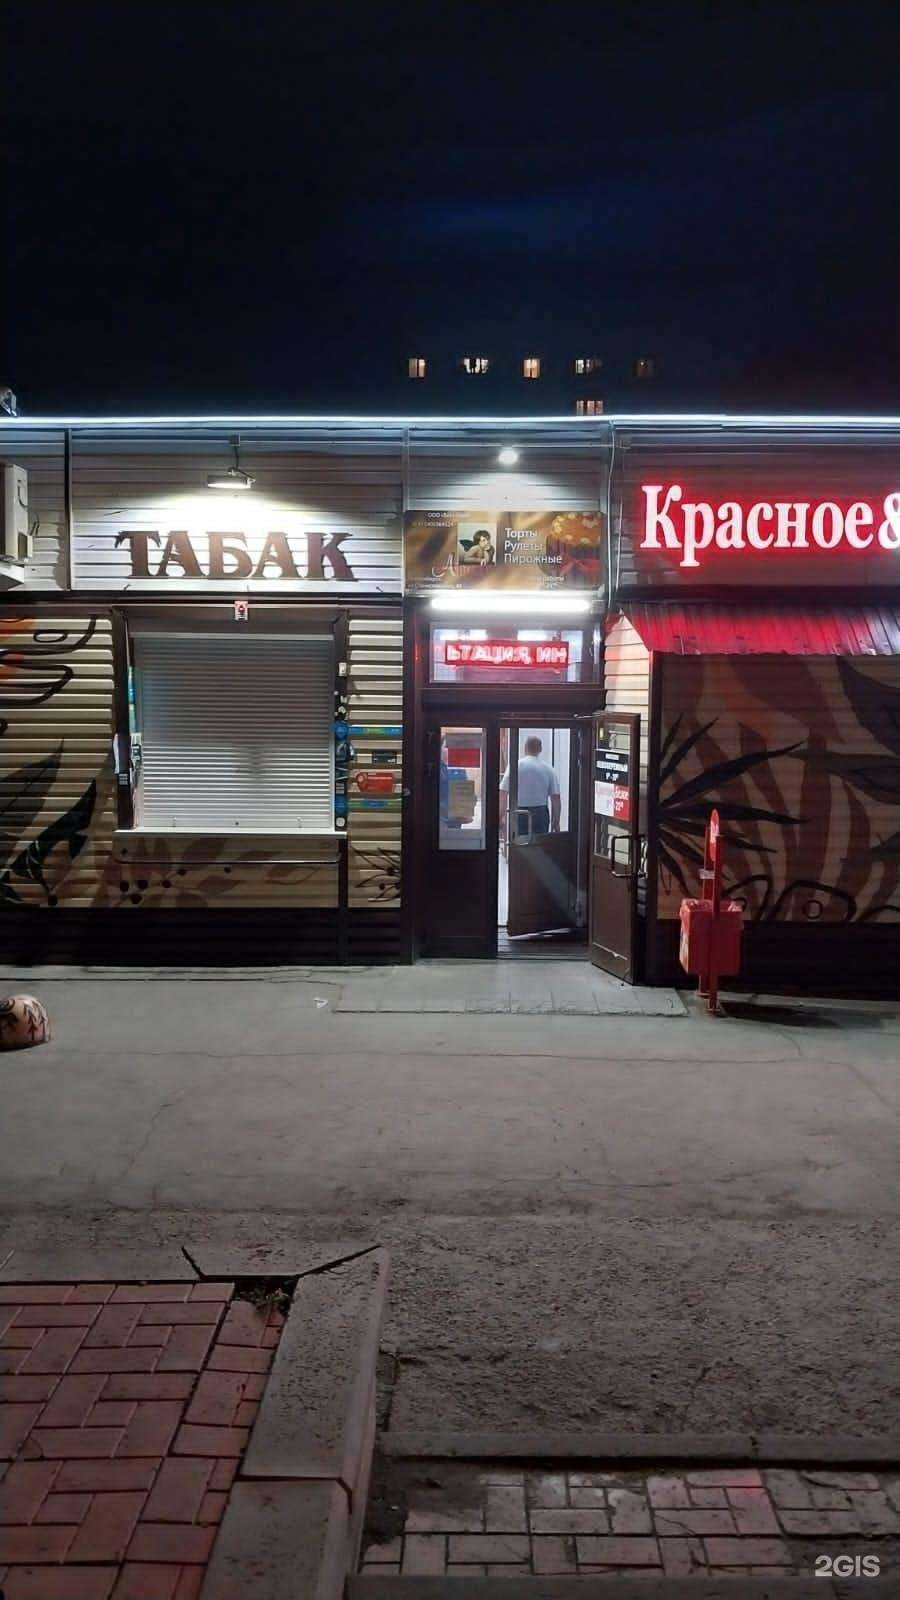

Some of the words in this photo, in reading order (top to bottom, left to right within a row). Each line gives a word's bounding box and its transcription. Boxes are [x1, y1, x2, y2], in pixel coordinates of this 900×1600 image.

[505, 528, 537, 540] Торты
[505, 541, 543, 553] Рулеты
[114, 530, 359, 582] ТАБАК
[504, 553, 562, 564] Пирожные
